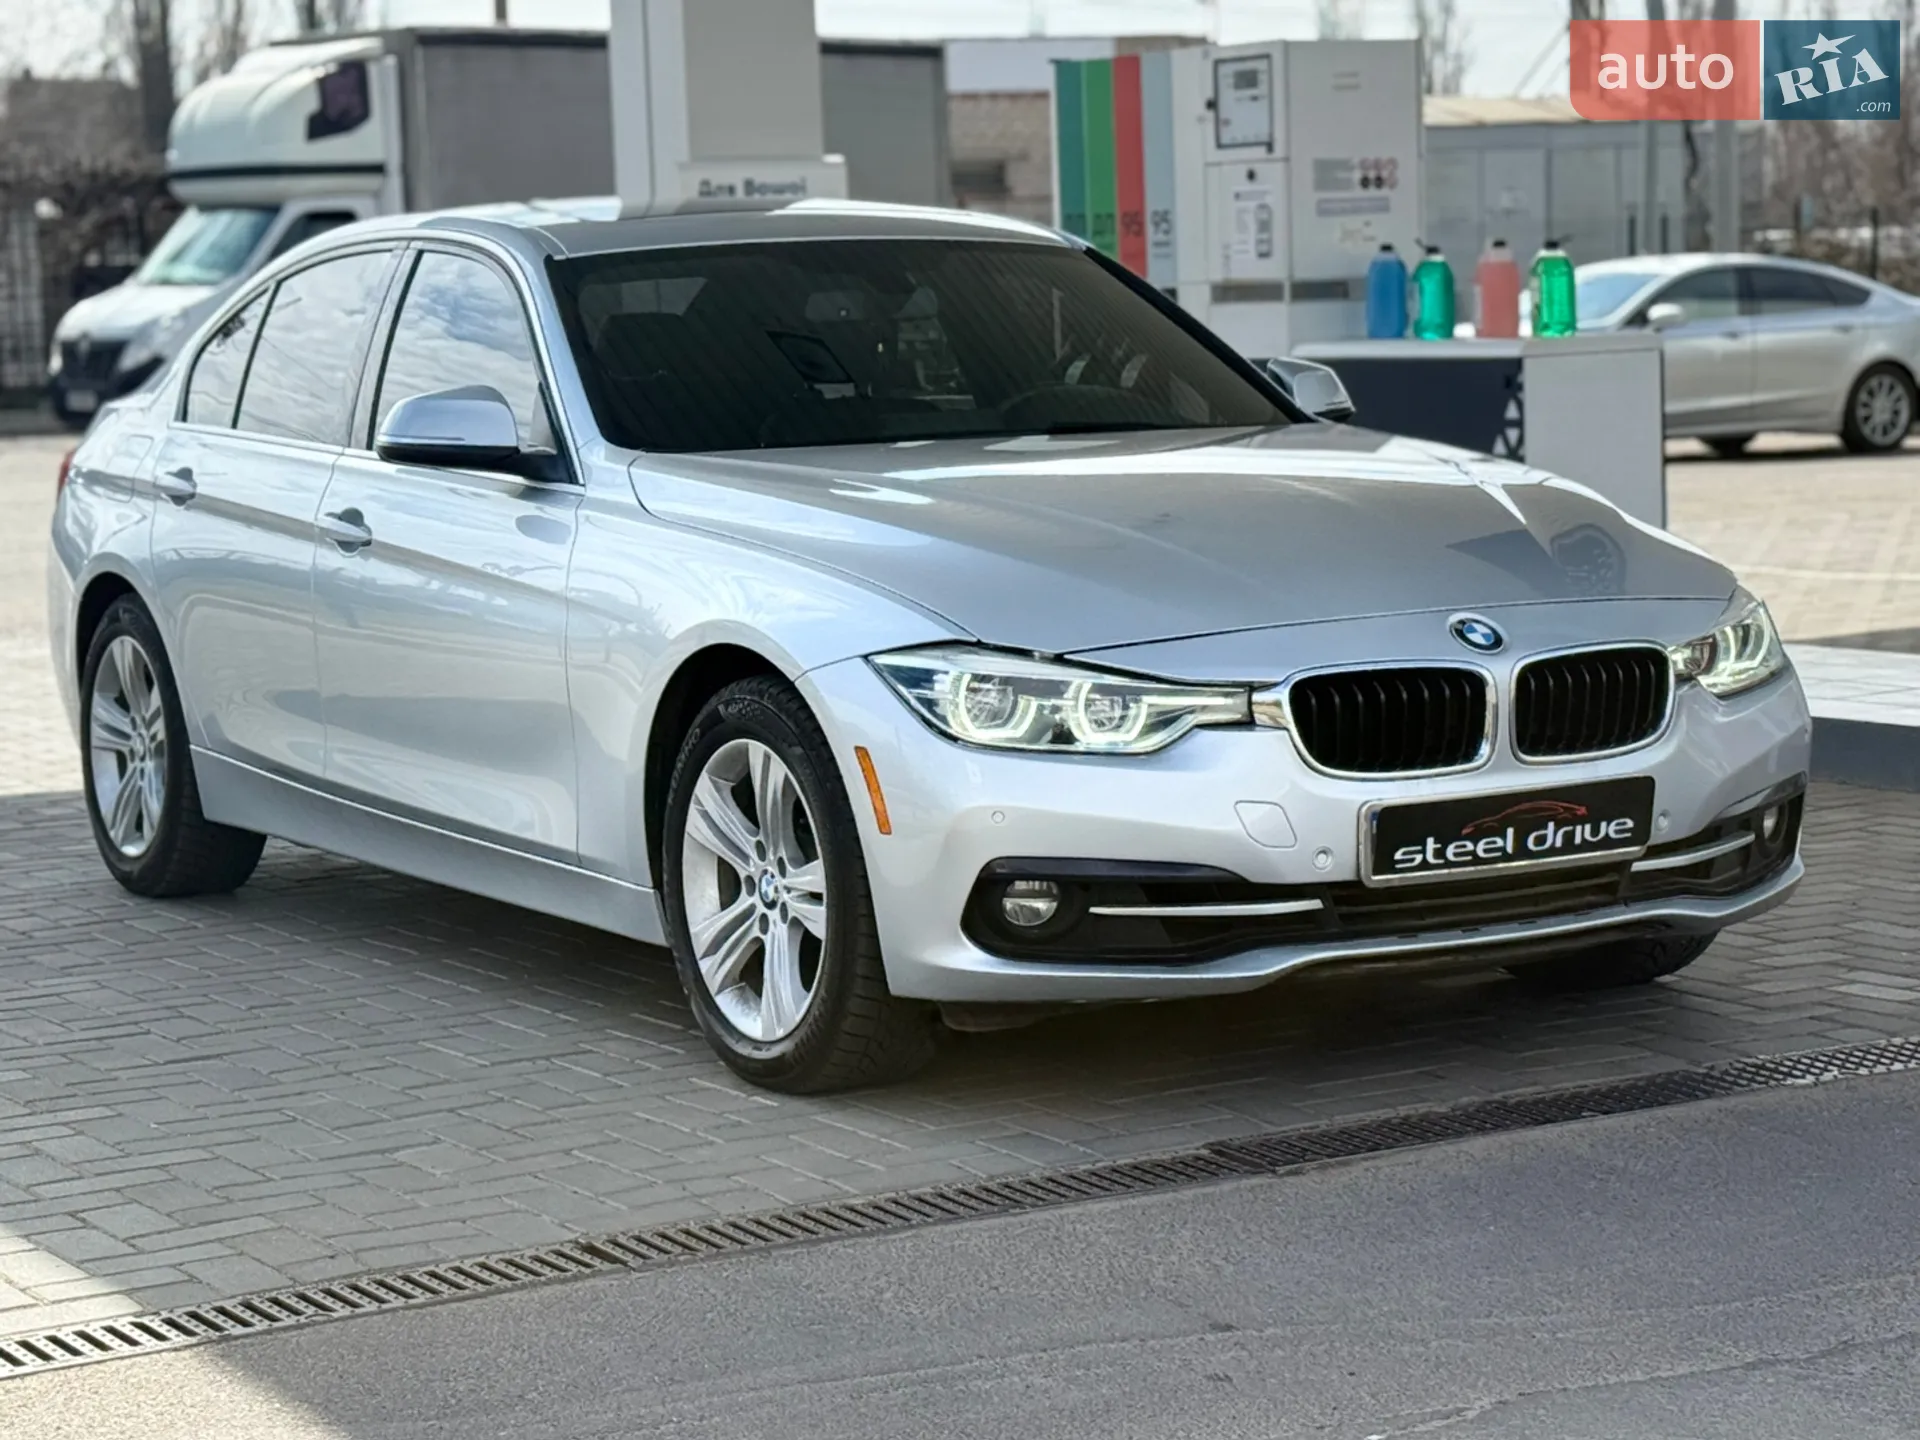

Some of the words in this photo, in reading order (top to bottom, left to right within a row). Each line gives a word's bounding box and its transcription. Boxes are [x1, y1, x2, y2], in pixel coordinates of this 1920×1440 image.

[1122, 209, 1144, 237] 95
[1150, 208, 1172, 236] 95
[1393, 827, 1515, 869] steel
[1526, 817, 1635, 852] drive
